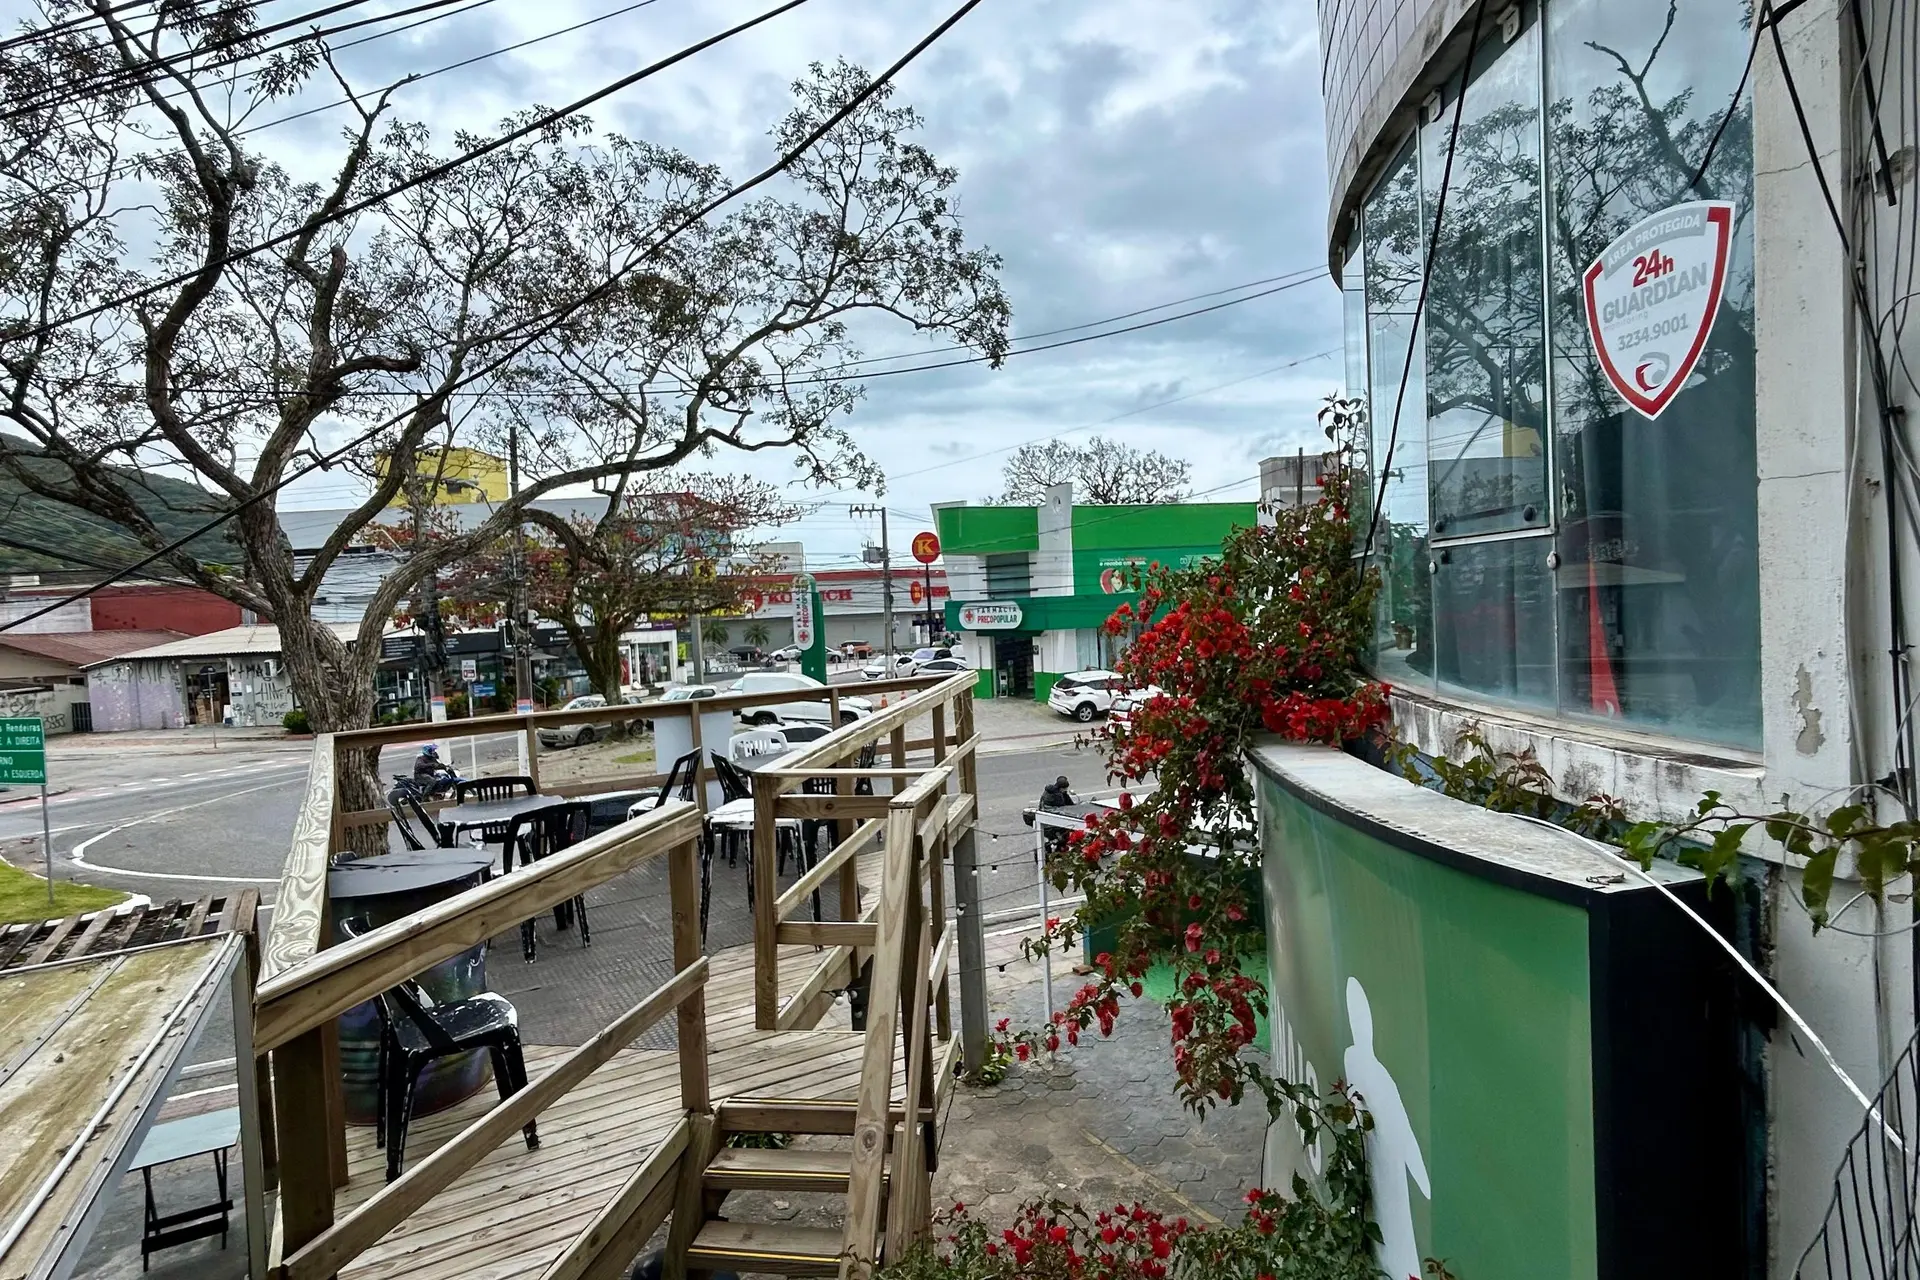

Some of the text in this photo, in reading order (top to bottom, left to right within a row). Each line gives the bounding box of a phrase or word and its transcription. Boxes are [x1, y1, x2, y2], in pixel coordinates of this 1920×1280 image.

[1635, 214, 1701, 247] PROTEGIDA
[1632, 249, 1674, 288] 24h
[1602, 262, 1707, 324] GUARDIAN
[1617, 312, 1689, 351] 3234.9001
[916, 539, 935, 556] K
[768, 589, 853, 605] KOICH
[6, 723, 41, 732] Rendeiras
[15, 736, 41, 746] DIREITA
[11, 769, 44, 779] ESQUERDA
